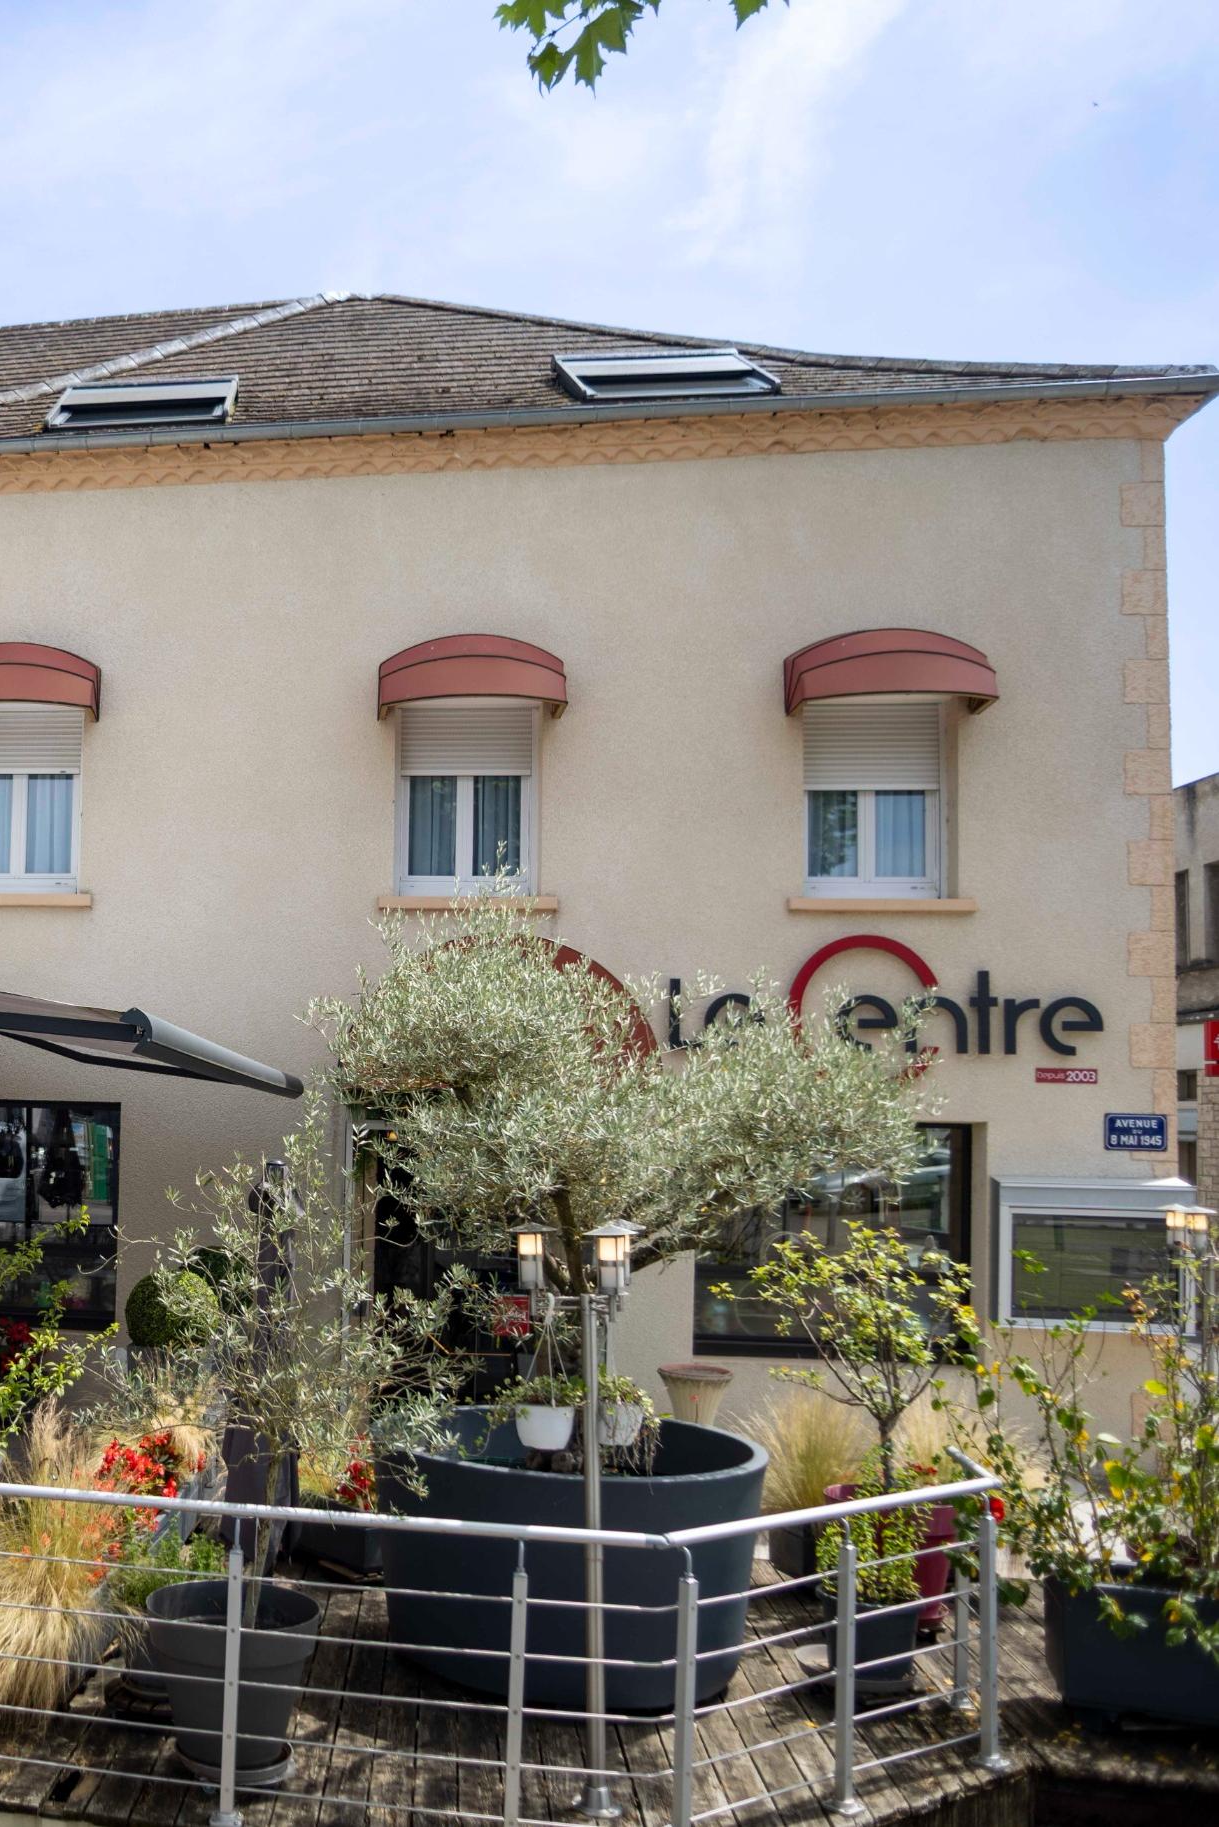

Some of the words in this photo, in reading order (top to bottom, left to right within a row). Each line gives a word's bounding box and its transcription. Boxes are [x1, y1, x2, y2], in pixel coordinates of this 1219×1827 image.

[788, 934, 1104, 1090] Centre
[1066, 1070, 1096, 1082] 2003
[1114, 1119, 1158, 1129] AVENUE
[1110, 1134, 1118, 1145] 8
[1120, 1134, 1138, 1145] MAI
[1140, 1135, 1163, 1146] 1945
